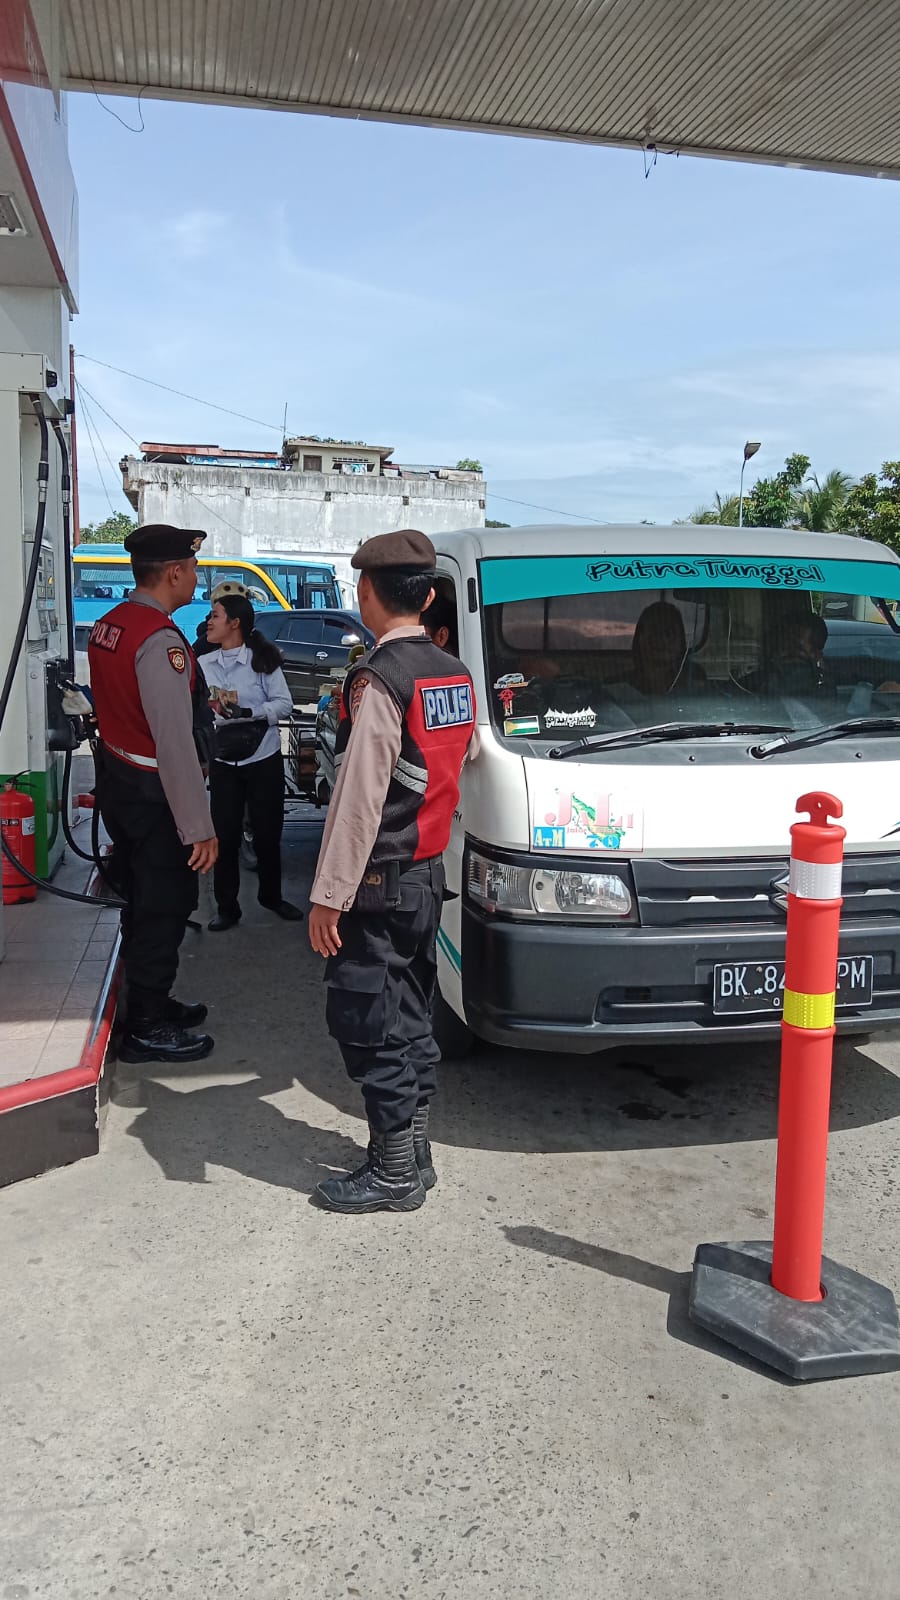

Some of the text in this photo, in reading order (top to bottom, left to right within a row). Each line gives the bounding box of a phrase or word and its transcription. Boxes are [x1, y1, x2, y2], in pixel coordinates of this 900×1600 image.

[587, 559, 825, 588] Putra Tunggal
[90, 622, 121, 650] POLISI
[425, 687, 472, 727] POLISI
[721, 968, 748, 996] BK
[837, 960, 866, 990] PM
